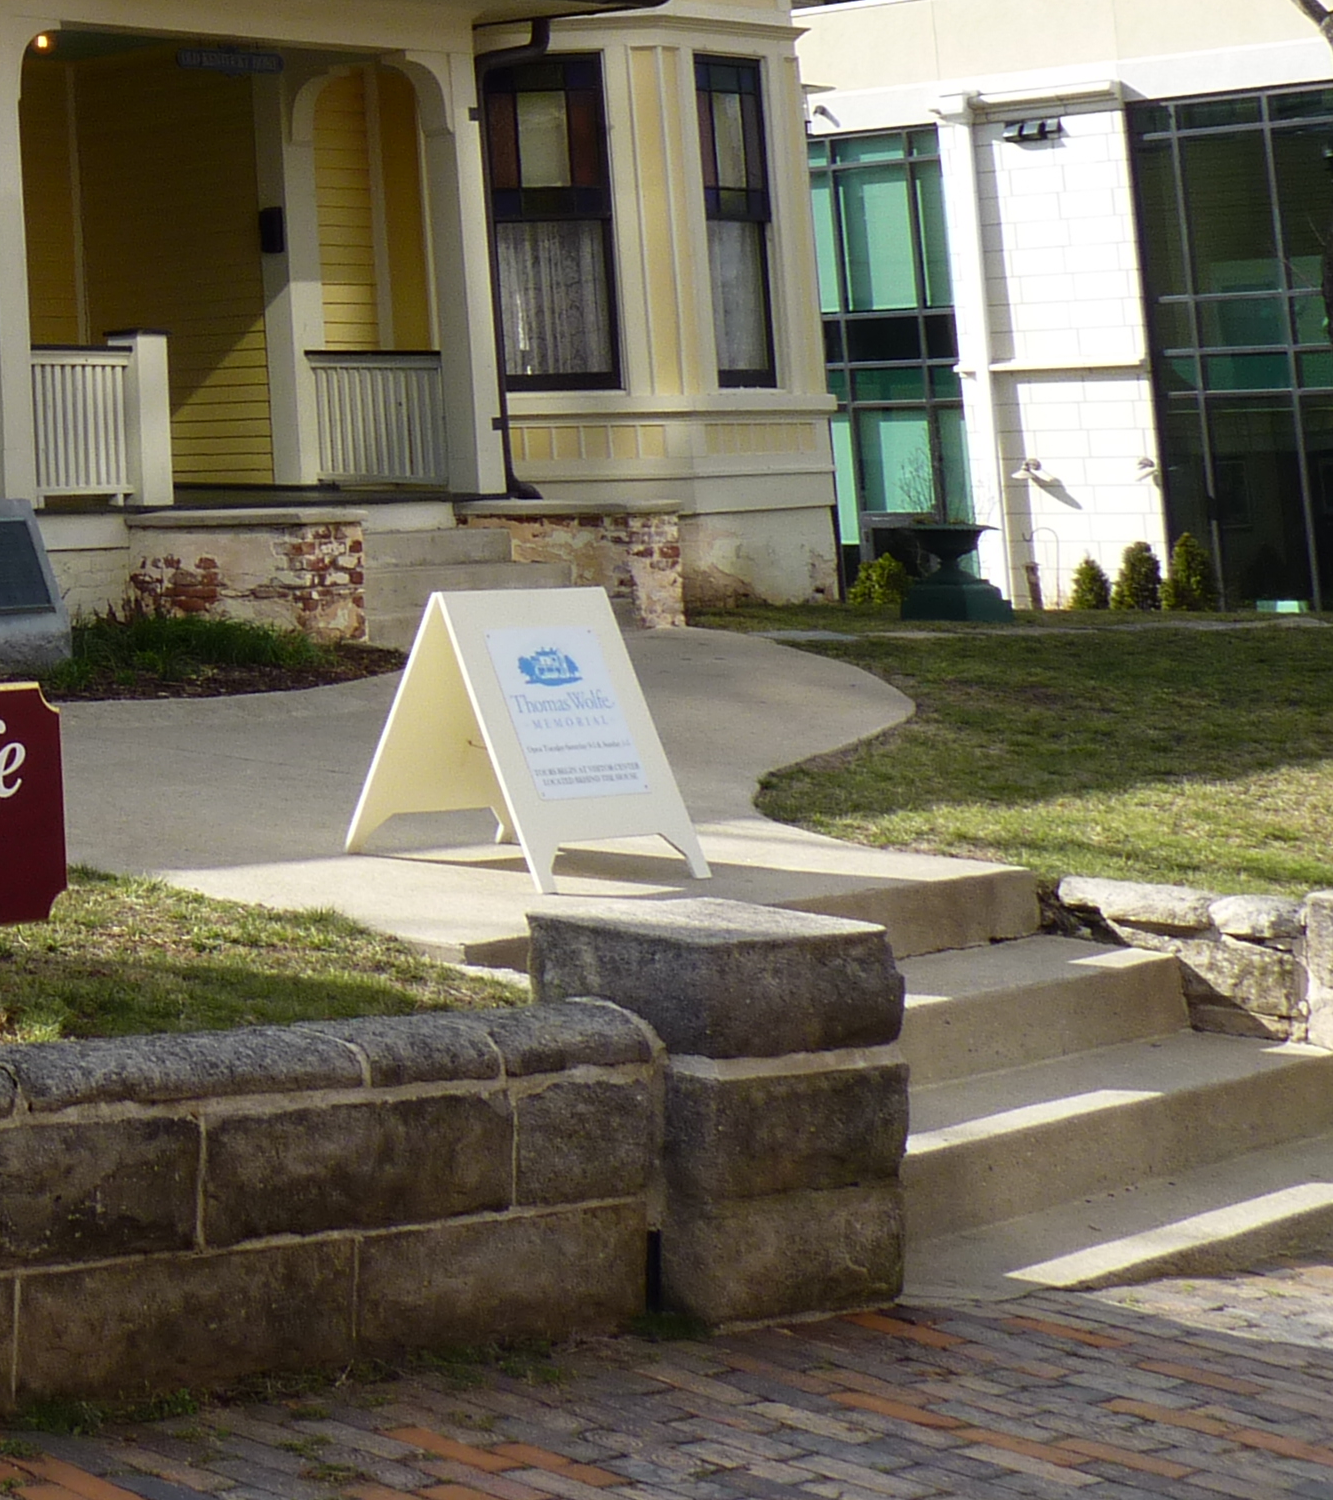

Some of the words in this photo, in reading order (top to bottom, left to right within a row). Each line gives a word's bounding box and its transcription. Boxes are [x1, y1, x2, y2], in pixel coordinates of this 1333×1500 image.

[510, 693, 571, 714] Thomas
[565, 688, 615, 711] Wolfe
[532, 715, 609, 729] MEMORIAL
[614, 762, 640, 771] CENTER
[542, 777, 574, 786] LOCATED
